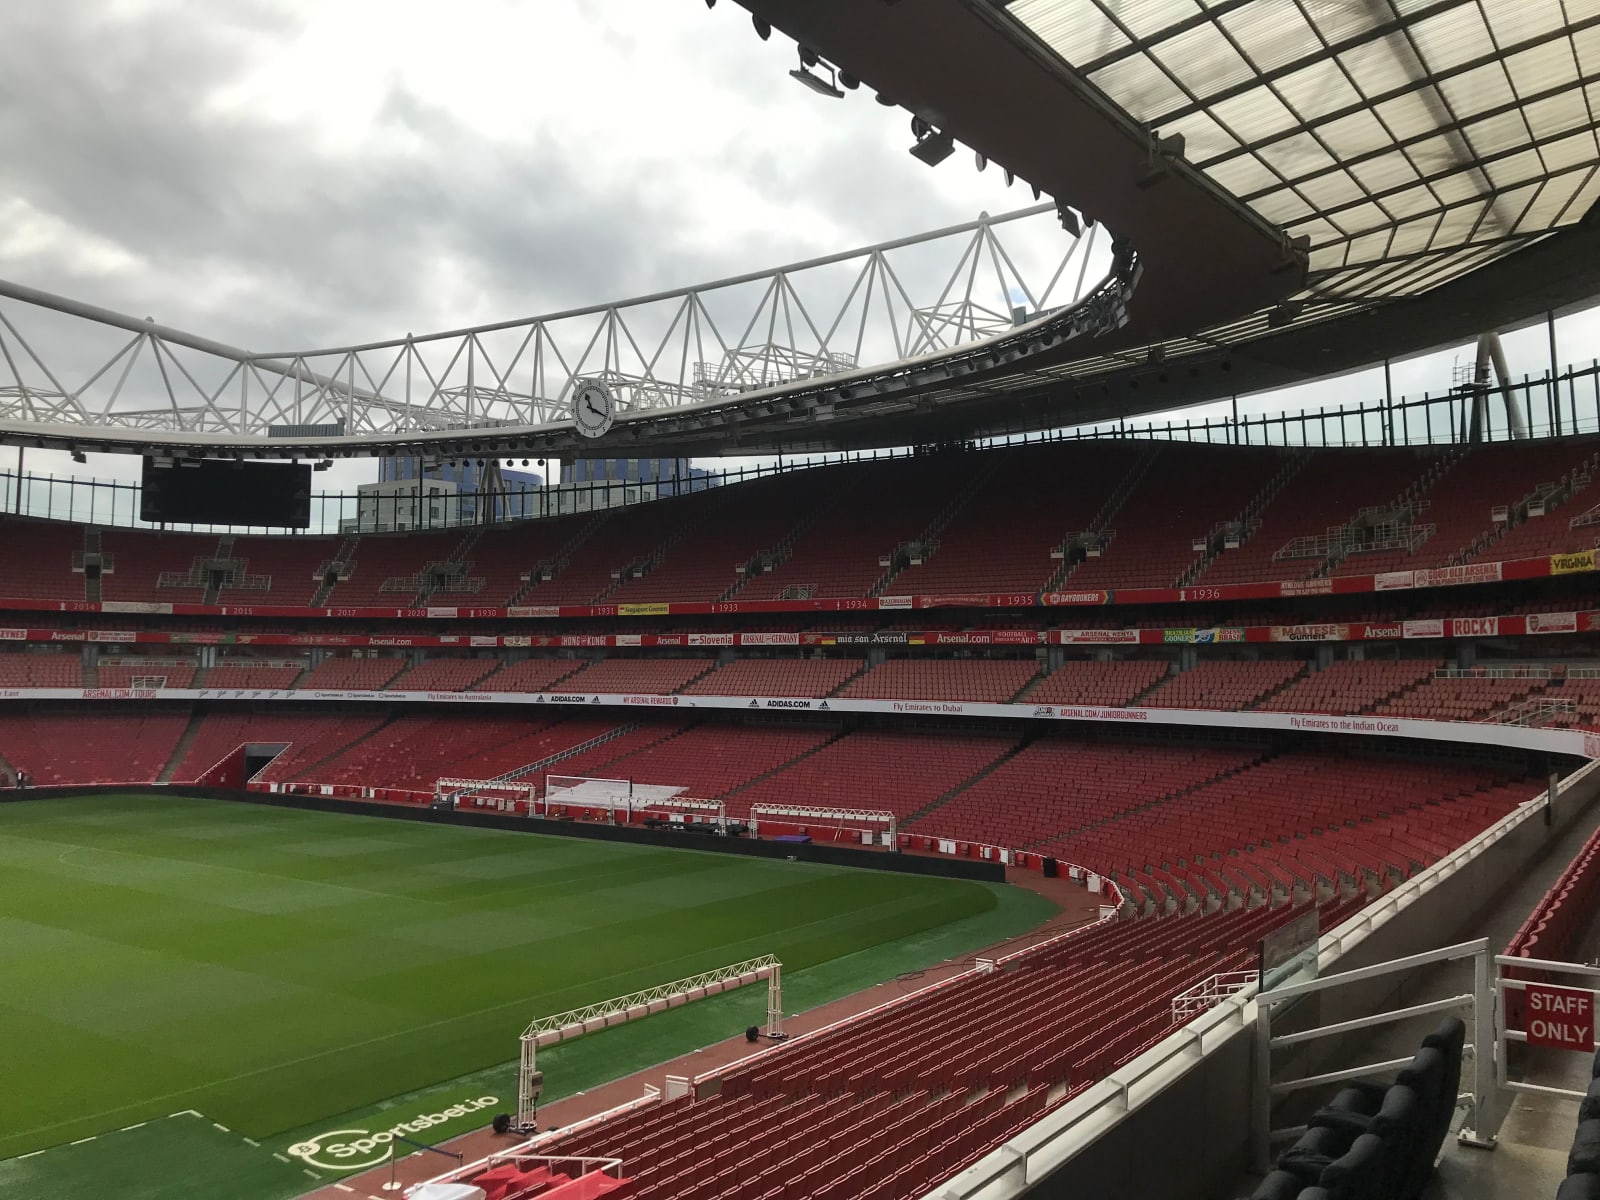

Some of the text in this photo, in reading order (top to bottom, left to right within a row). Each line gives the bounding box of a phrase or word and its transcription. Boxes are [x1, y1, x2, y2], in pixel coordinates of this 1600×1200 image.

[1553, 556, 1592, 569] VIRGINIA
[1465, 563, 1498, 576] ARSENAL
[1192, 588, 1220, 600] 1936
[846, 600, 867, 609] 1934
[1008, 596, 1033, 606] 1935
[720, 604, 738, 612] 1933
[1282, 626, 1336, 636] MALTESE
[1364, 624, 1400, 638] Arsenal
[1454, 618, 1496, 635] ROCKY
[51, 631, 86, 640] Arsenal
[657, 636, 681, 645] Arsenal
[699, 635, 732, 644] Slovenia
[742, 634, 798, 644] ARSENAL GERMANY
[937, 633, 990, 644] Arsenal.com
[1289, 632, 1326, 640] Gunners
[368, 637, 412, 646] Arsenal.com
[767, 700, 811, 708] ADIDAS.COM
[894, 703, 903, 712] Fly
[1290, 717, 1399, 732] Fly Emirates to the Indian Ocean
[1530, 992, 1588, 1016] STAFF
[1530, 1020, 1588, 1044] ONLY
[326, 1096, 499, 1158] Sportsbet.io
